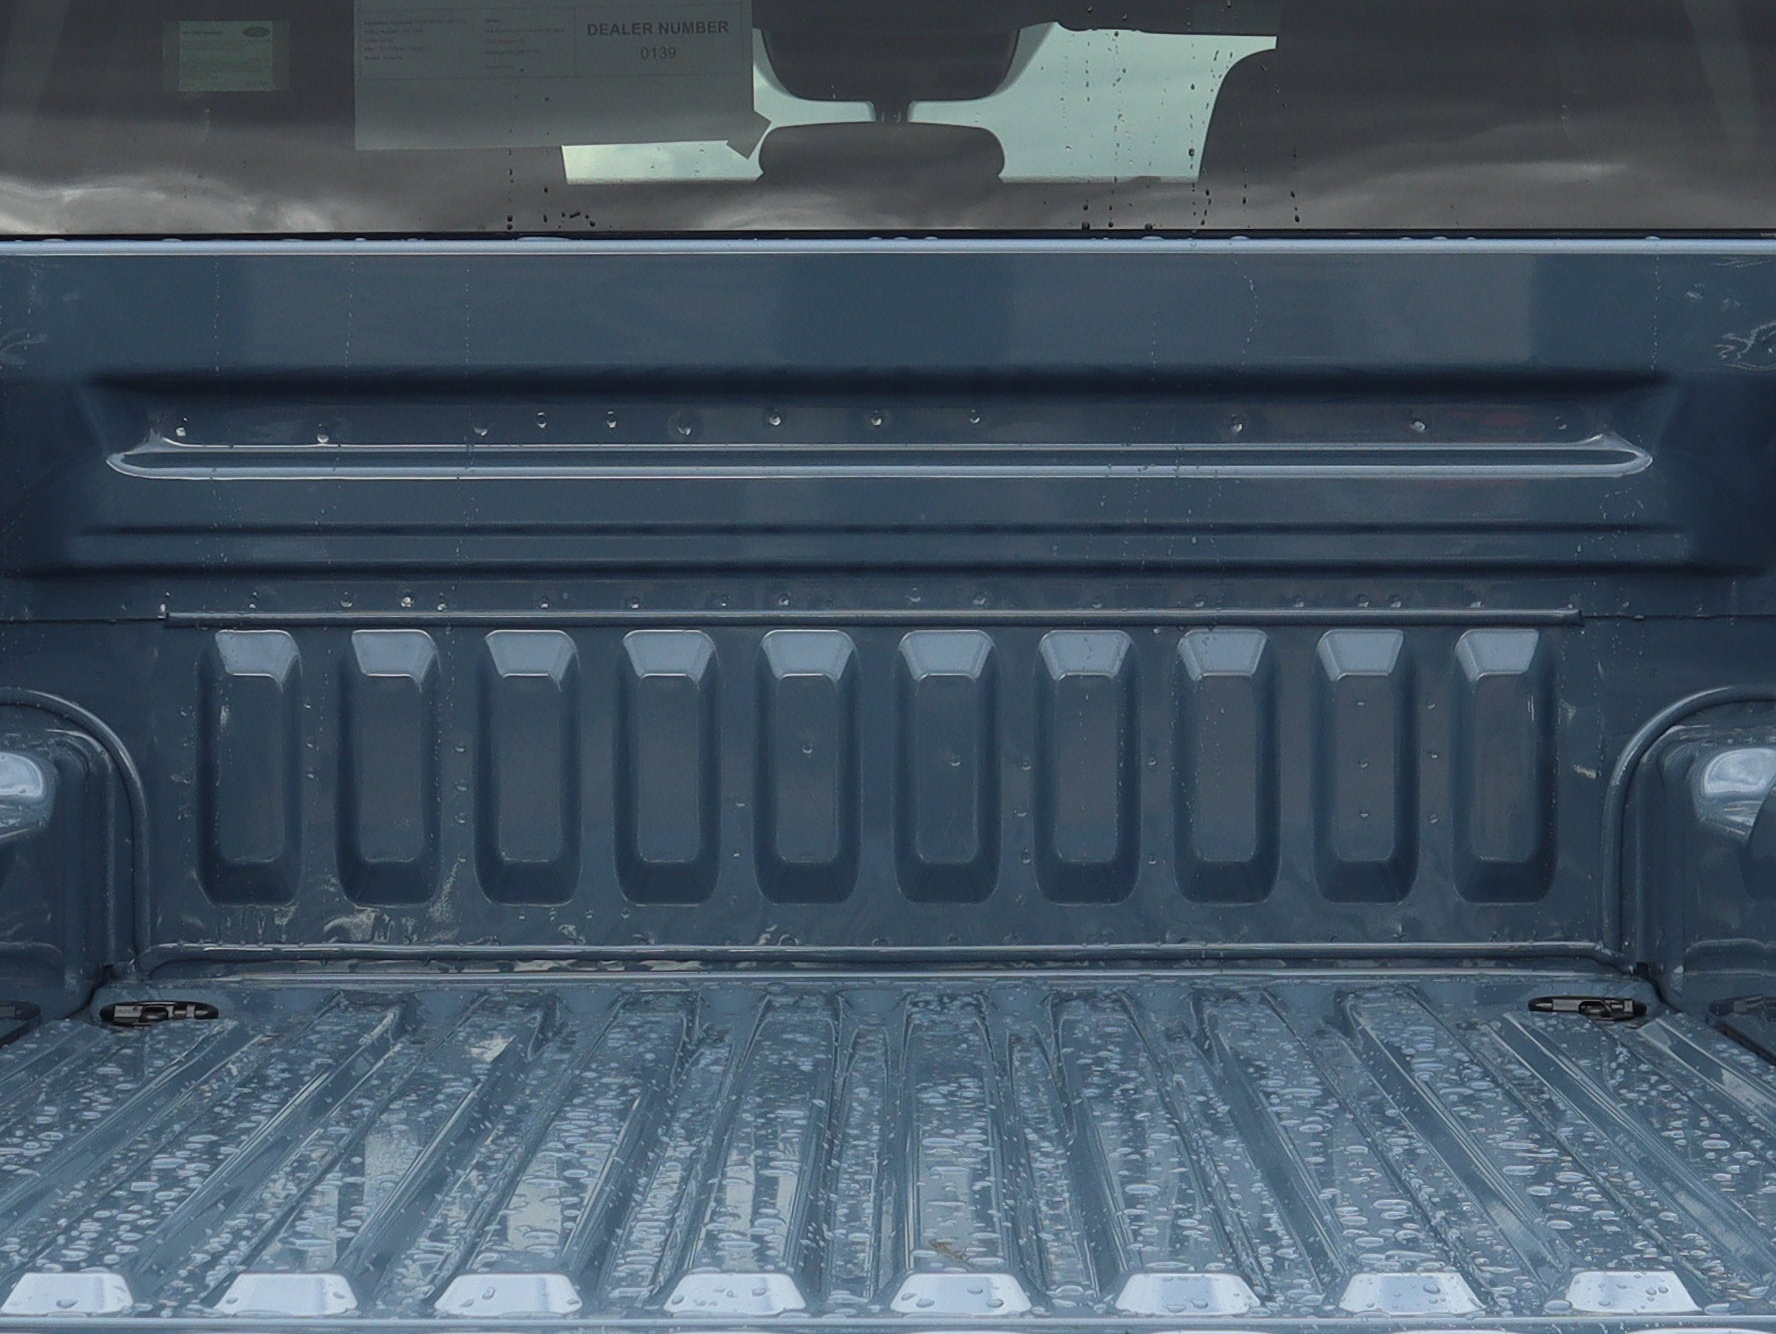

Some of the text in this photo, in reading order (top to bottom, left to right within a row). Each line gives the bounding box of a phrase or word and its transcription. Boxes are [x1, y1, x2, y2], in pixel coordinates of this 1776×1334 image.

[587, 20, 729, 36] DEALER NUMBER
[640, 46, 677, 60] 0139
